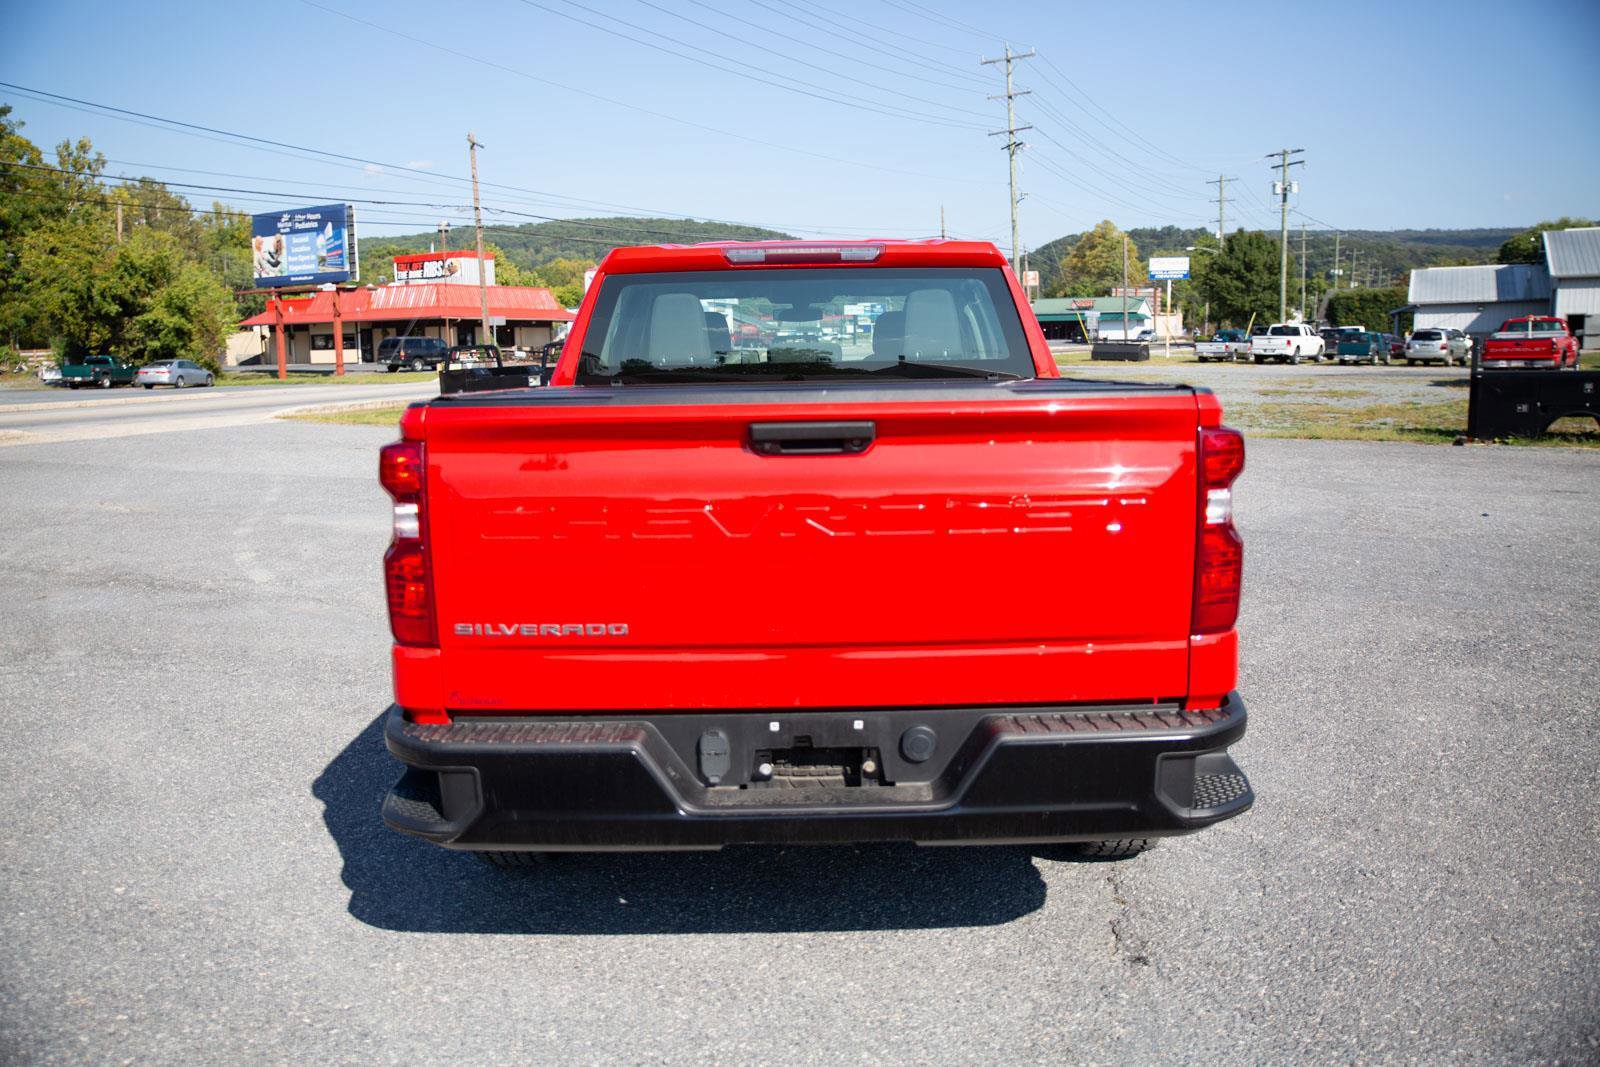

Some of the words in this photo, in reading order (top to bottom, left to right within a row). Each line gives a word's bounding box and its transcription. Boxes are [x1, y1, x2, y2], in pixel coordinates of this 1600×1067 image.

[295, 221, 318, 229] Pediatrics
[423, 260, 444, 278] RIBS
[480, 496, 1147, 540] CHEVROLET
[454, 623, 629, 636] SILVERADO
